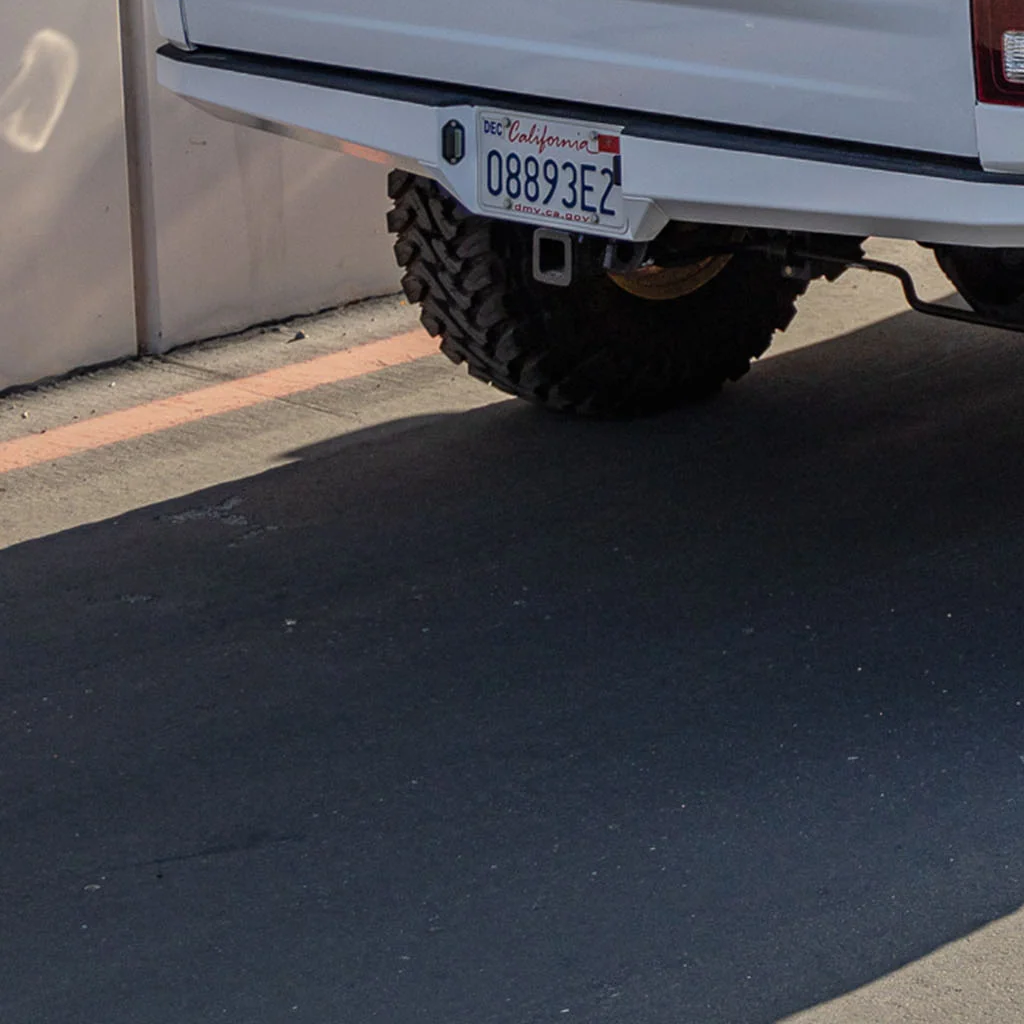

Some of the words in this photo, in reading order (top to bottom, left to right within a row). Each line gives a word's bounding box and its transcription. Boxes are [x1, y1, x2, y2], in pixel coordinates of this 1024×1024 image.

[484, 120, 502, 136] DEC
[508, 120, 600, 154] California
[487, 149, 615, 216] 08893E2
[514, 203, 590, 222] dmv.ca.gov
